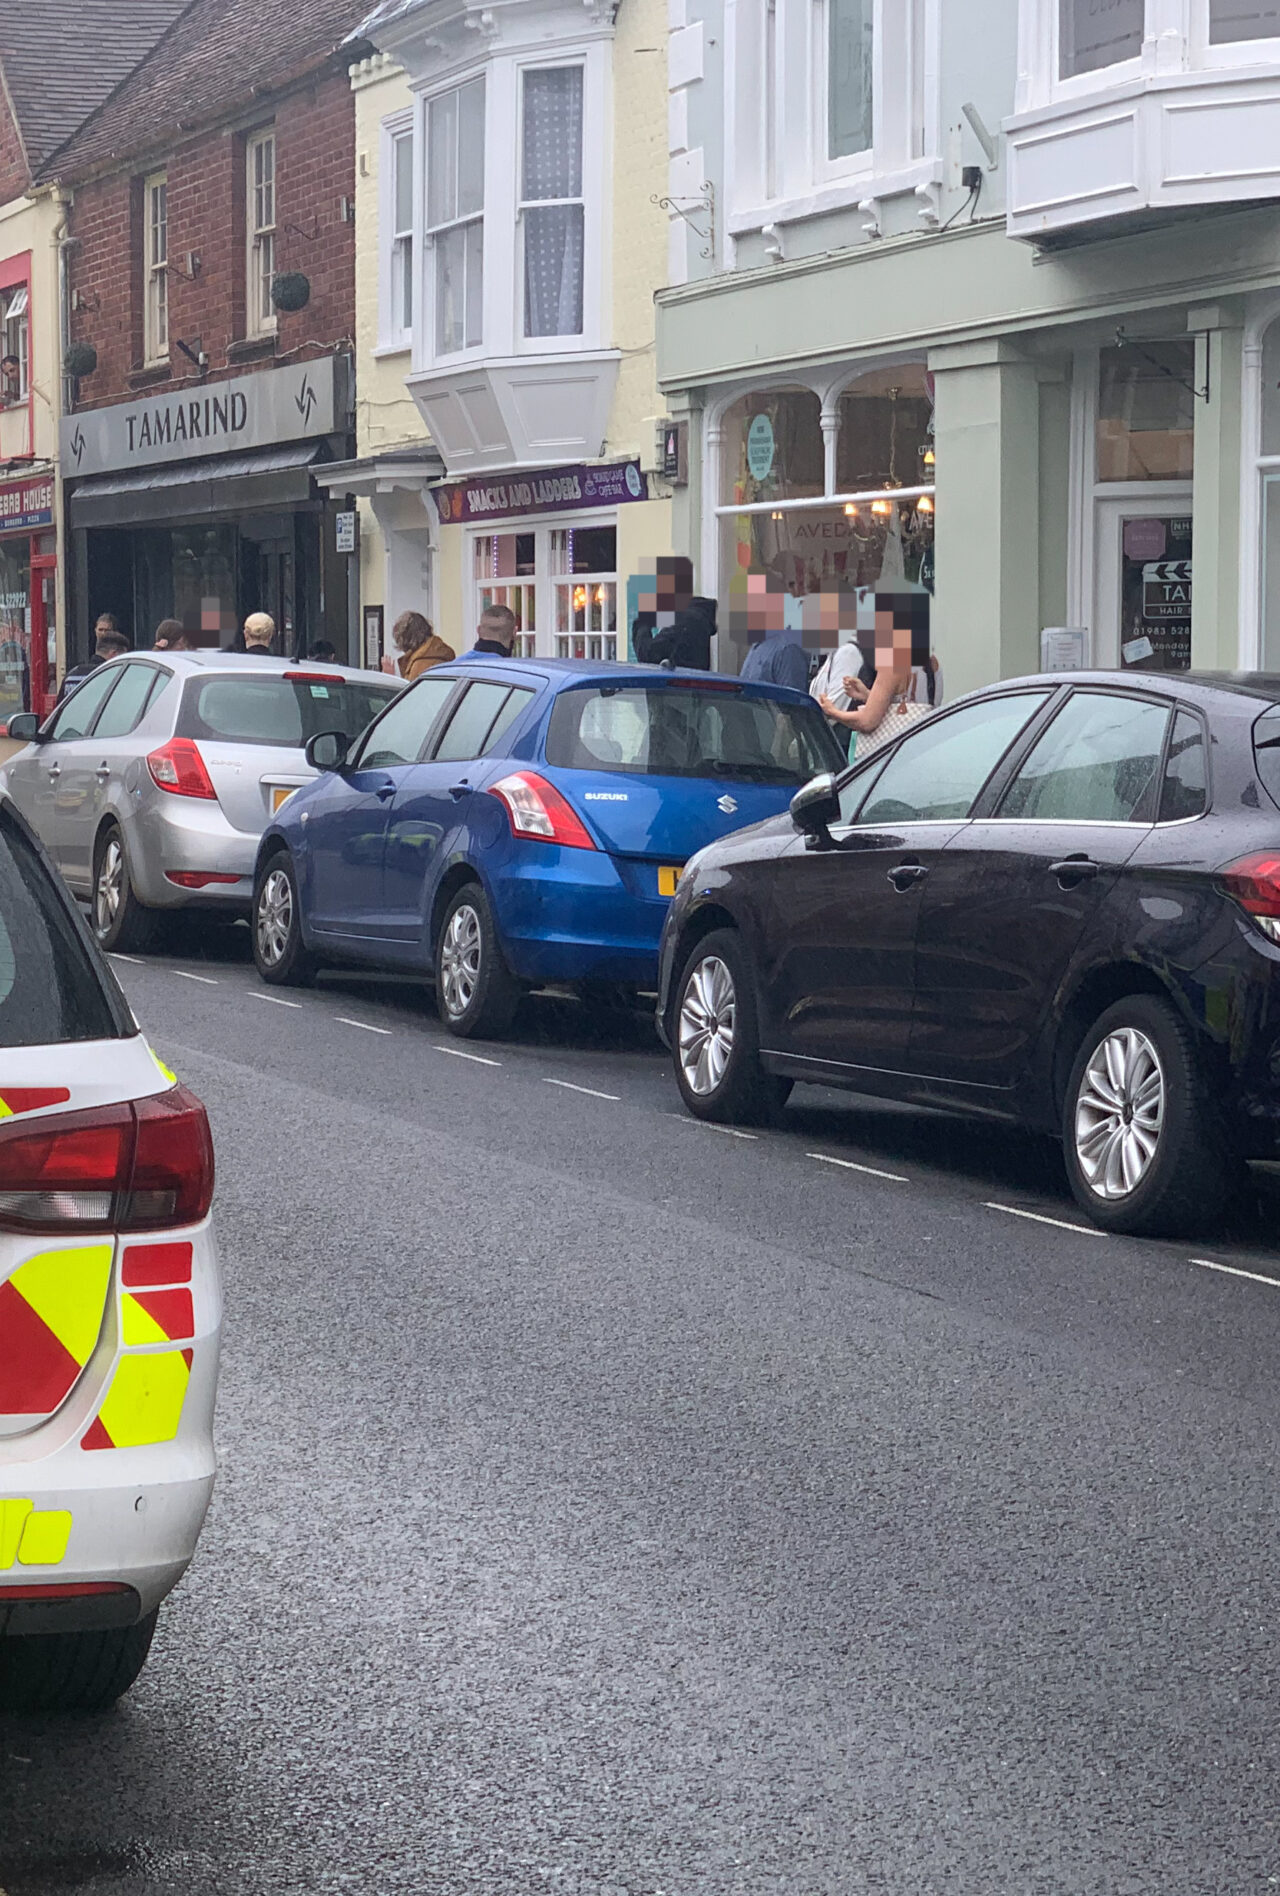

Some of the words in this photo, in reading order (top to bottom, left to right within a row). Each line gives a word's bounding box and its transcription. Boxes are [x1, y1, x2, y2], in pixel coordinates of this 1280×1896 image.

[125, 391, 247, 451] TAMARIND
[23, 485, 51, 513] HOUSE
[467, 486, 508, 513] SNACKS
[509, 482, 532, 508] AND
[532, 476, 582, 504] LADDERS
[1163, 584, 1192, 601] TA
[1160, 607, 1183, 615] HAIR
[1171, 626, 1190, 635] 528
[584, 792, 628, 801] SUZUKI
